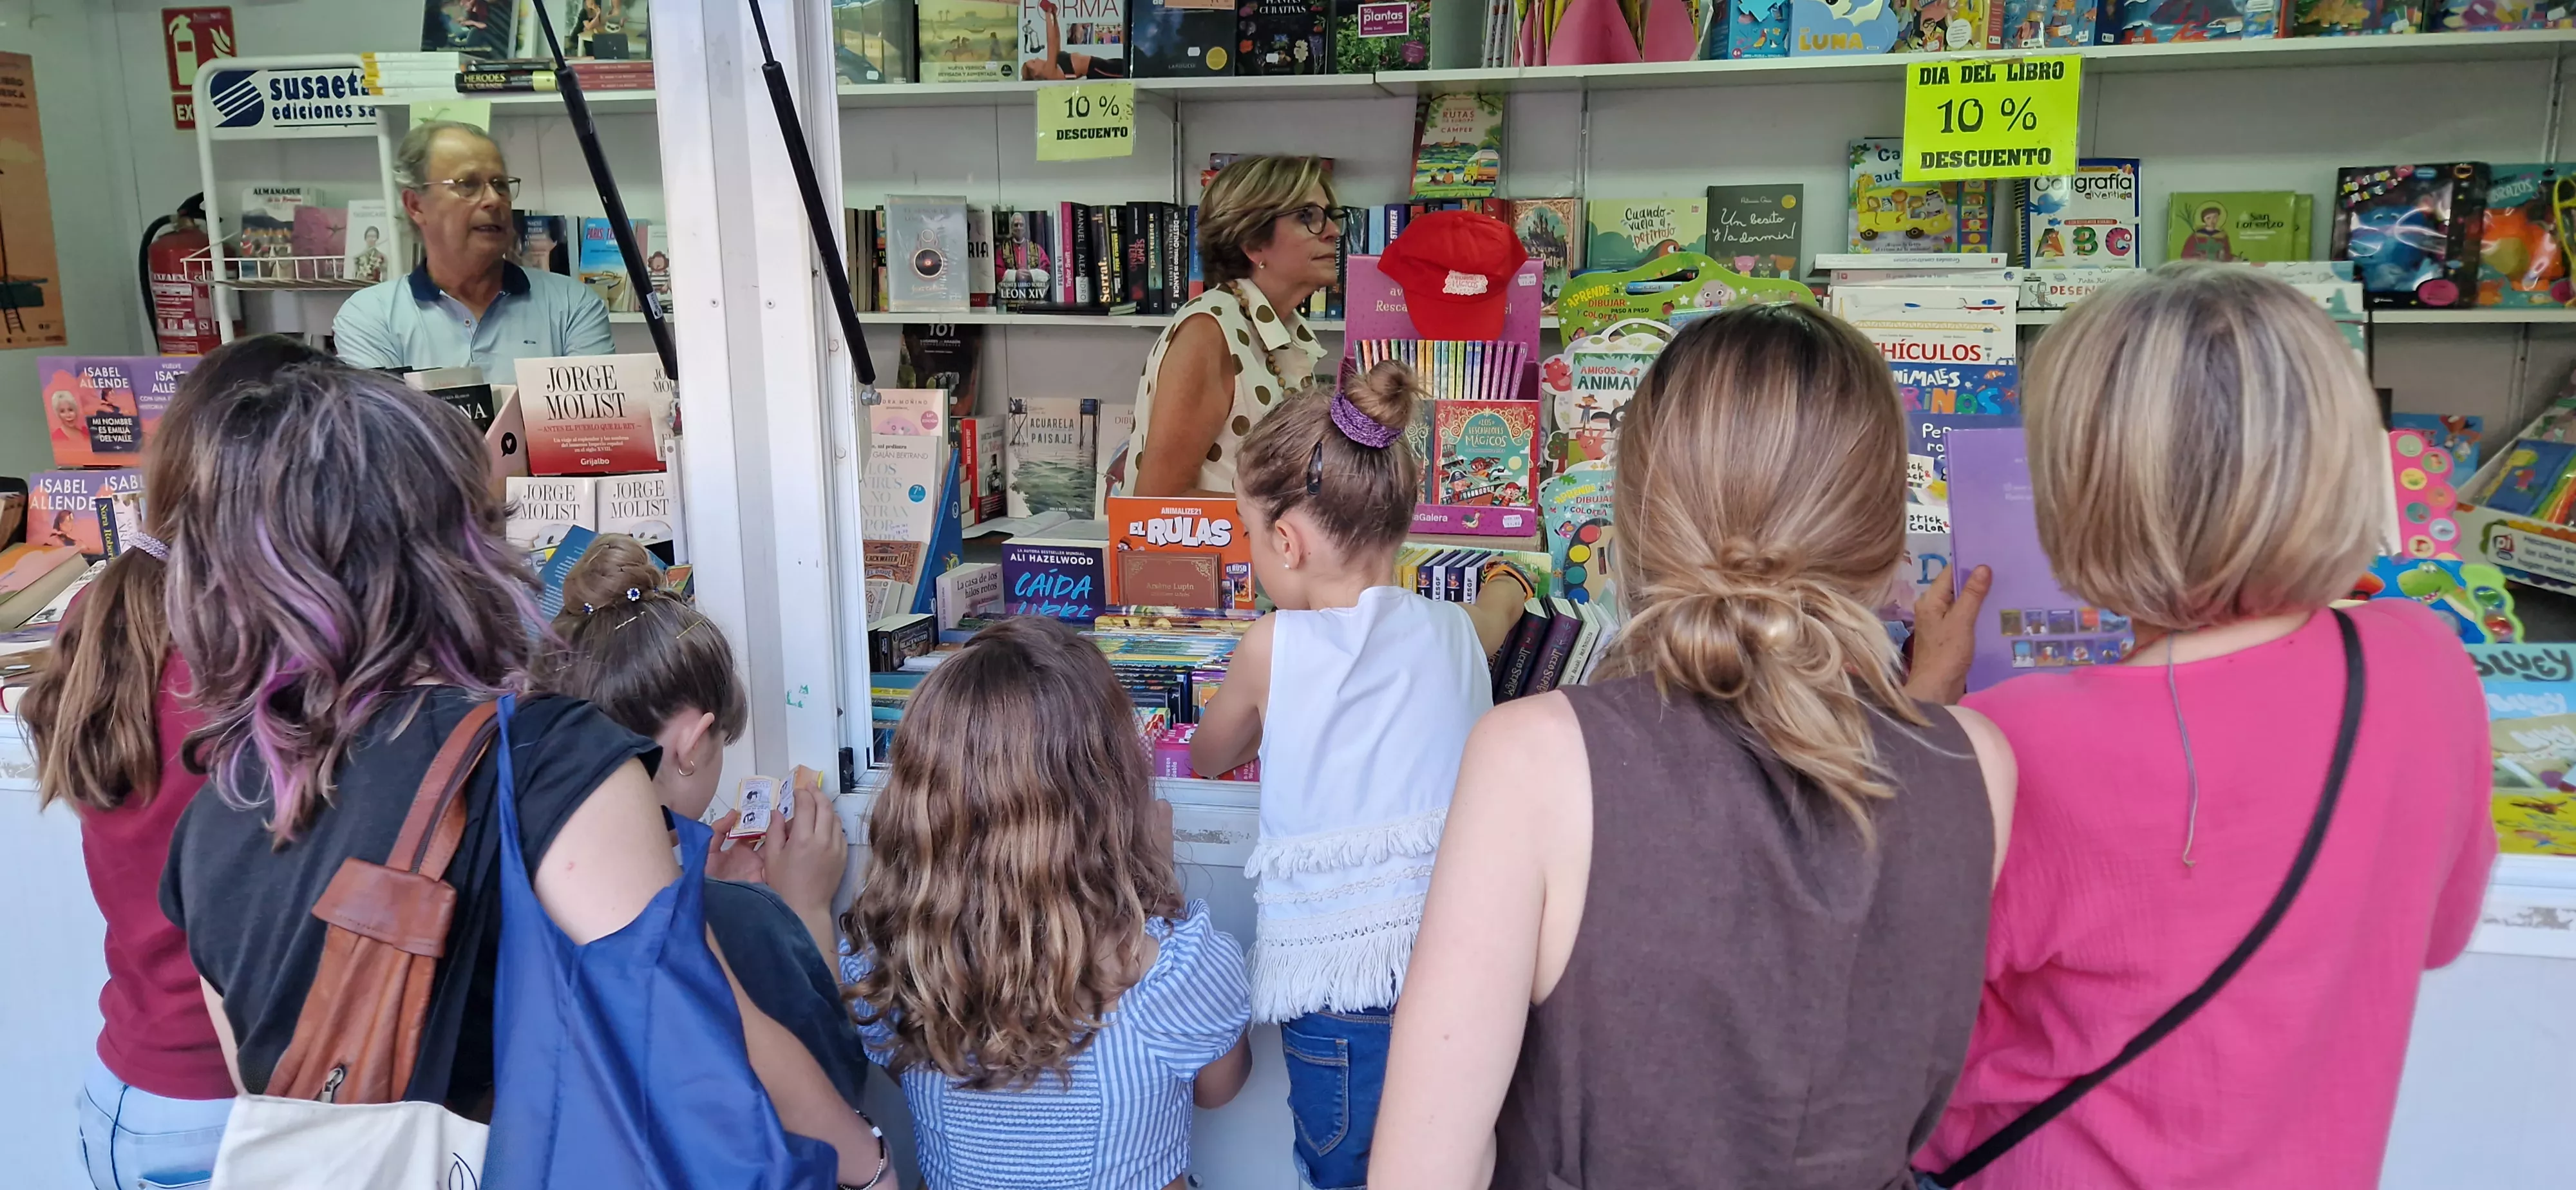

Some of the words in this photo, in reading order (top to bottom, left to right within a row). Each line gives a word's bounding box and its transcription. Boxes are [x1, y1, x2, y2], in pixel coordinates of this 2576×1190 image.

[1024, 0, 1119, 19] FORMA
[1260, 5, 1306, 14] CURATIVAS
[1363, 10, 1403, 24] plantas
[1799, 32, 1864, 51] LUNA
[464, 73, 506, 82] HERODES
[1919, 66, 1950, 86] DIA
[1960, 64, 1996, 84] DEL
[2007, 61, 2065, 82] LIBRO
[272, 101, 352, 121] ediciones
[1065, 96, 1090, 118] 10
[1099, 95, 1119, 117] %
[1937, 98, 1984, 133] 10
[2001, 97, 2038, 131] %
[1056, 126, 1128, 140] DESCUENTO
[1920, 147, 2052, 169] DESCUENTO
[2085, 191, 2132, 200] divertida
[1625, 205, 1667, 221] Cuando
[1721, 208, 1747, 227] Un
[1750, 211, 1786, 225] besito
[2250, 212, 2270, 222] San
[1077, 209, 1085, 243] MANUEL
[1390, 209, 1398, 240] STRIKER
[1629, 219, 1654, 232] vuela
[1633, 223, 1677, 243] petirrojo
[1712, 227, 1721, 241] y
[1739, 222, 1796, 243] dormir!
[2072, 226, 2099, 256] B
[1540, 252, 1564, 268] Potter
[1077, 253, 1087, 301] ALEJANDRO
[1028, 288, 1047, 299] XIV
[1566, 284, 1611, 308] APRENDE
[1376, 299, 1408, 312] Resca
[1588, 299, 1626, 308] DIBUJAR
[1583, 310, 1619, 322] COLOREA
[929, 323, 956, 337] 101
[1875, 339, 1982, 361] HÍCULOS
[84, 366, 121, 377] ISABEL
[1580, 366, 1617, 375] AMIGOS
[80, 377, 129, 388] ALLENDE
[547, 364, 619, 393] JORGE
[543, 392, 627, 421] MOLIST
[98, 426, 108, 434] ES
[108, 426, 131, 434] EMILIA
[1030, 417, 1075, 430] ACUARELA
[1468, 426, 1504, 435] RESCATADORES
[113, 435, 133, 443] VALLE
[1031, 433, 1073, 444] PAISAJE
[1465, 435, 1508, 448] MÁGICOS
[580, 458, 611, 466] Grijalbo
[873, 451, 895, 459] GALÁN
[869, 463, 897, 476] LOS
[40, 478, 88, 494] ISABEL
[524, 484, 576, 502] JORGE
[613, 480, 665, 500] JORGE
[871, 491, 891, 504] NO
[1554, 483, 1596, 504] APRENDE
[30, 496, 97, 511] ALLENDE
[611, 498, 670, 519] MOLIST
[99, 503, 109, 527] Nora
[520, 502, 580, 521] MOLIST
[1160, 507, 1202, 516] ANIMALIZE21
[1570, 506, 1607, 517] COLOREA
[864, 519, 894, 532] POR
[1909, 514, 1942, 525] stick
[1129, 520, 1147, 536] EL
[1146, 515, 1233, 547] RULAS
[1909, 523, 1946, 534] COLOR
[1010, 553, 1026, 562] ALI
[1029, 554, 1094, 565] HAZELWOOD
[1232, 564, 1247, 572] RUSO
[957, 580, 964, 591] La
[965, 577, 978, 589] casa
[979, 574, 987, 584] de
[988, 571, 998, 582] los
[1014, 568, 1094, 601] CAÍDA
[1173, 583, 1195, 591] Lupin
[965, 586, 980, 599] hilos
[981, 583, 998, 594] rotos
[1450, 590, 1455, 601] 1
